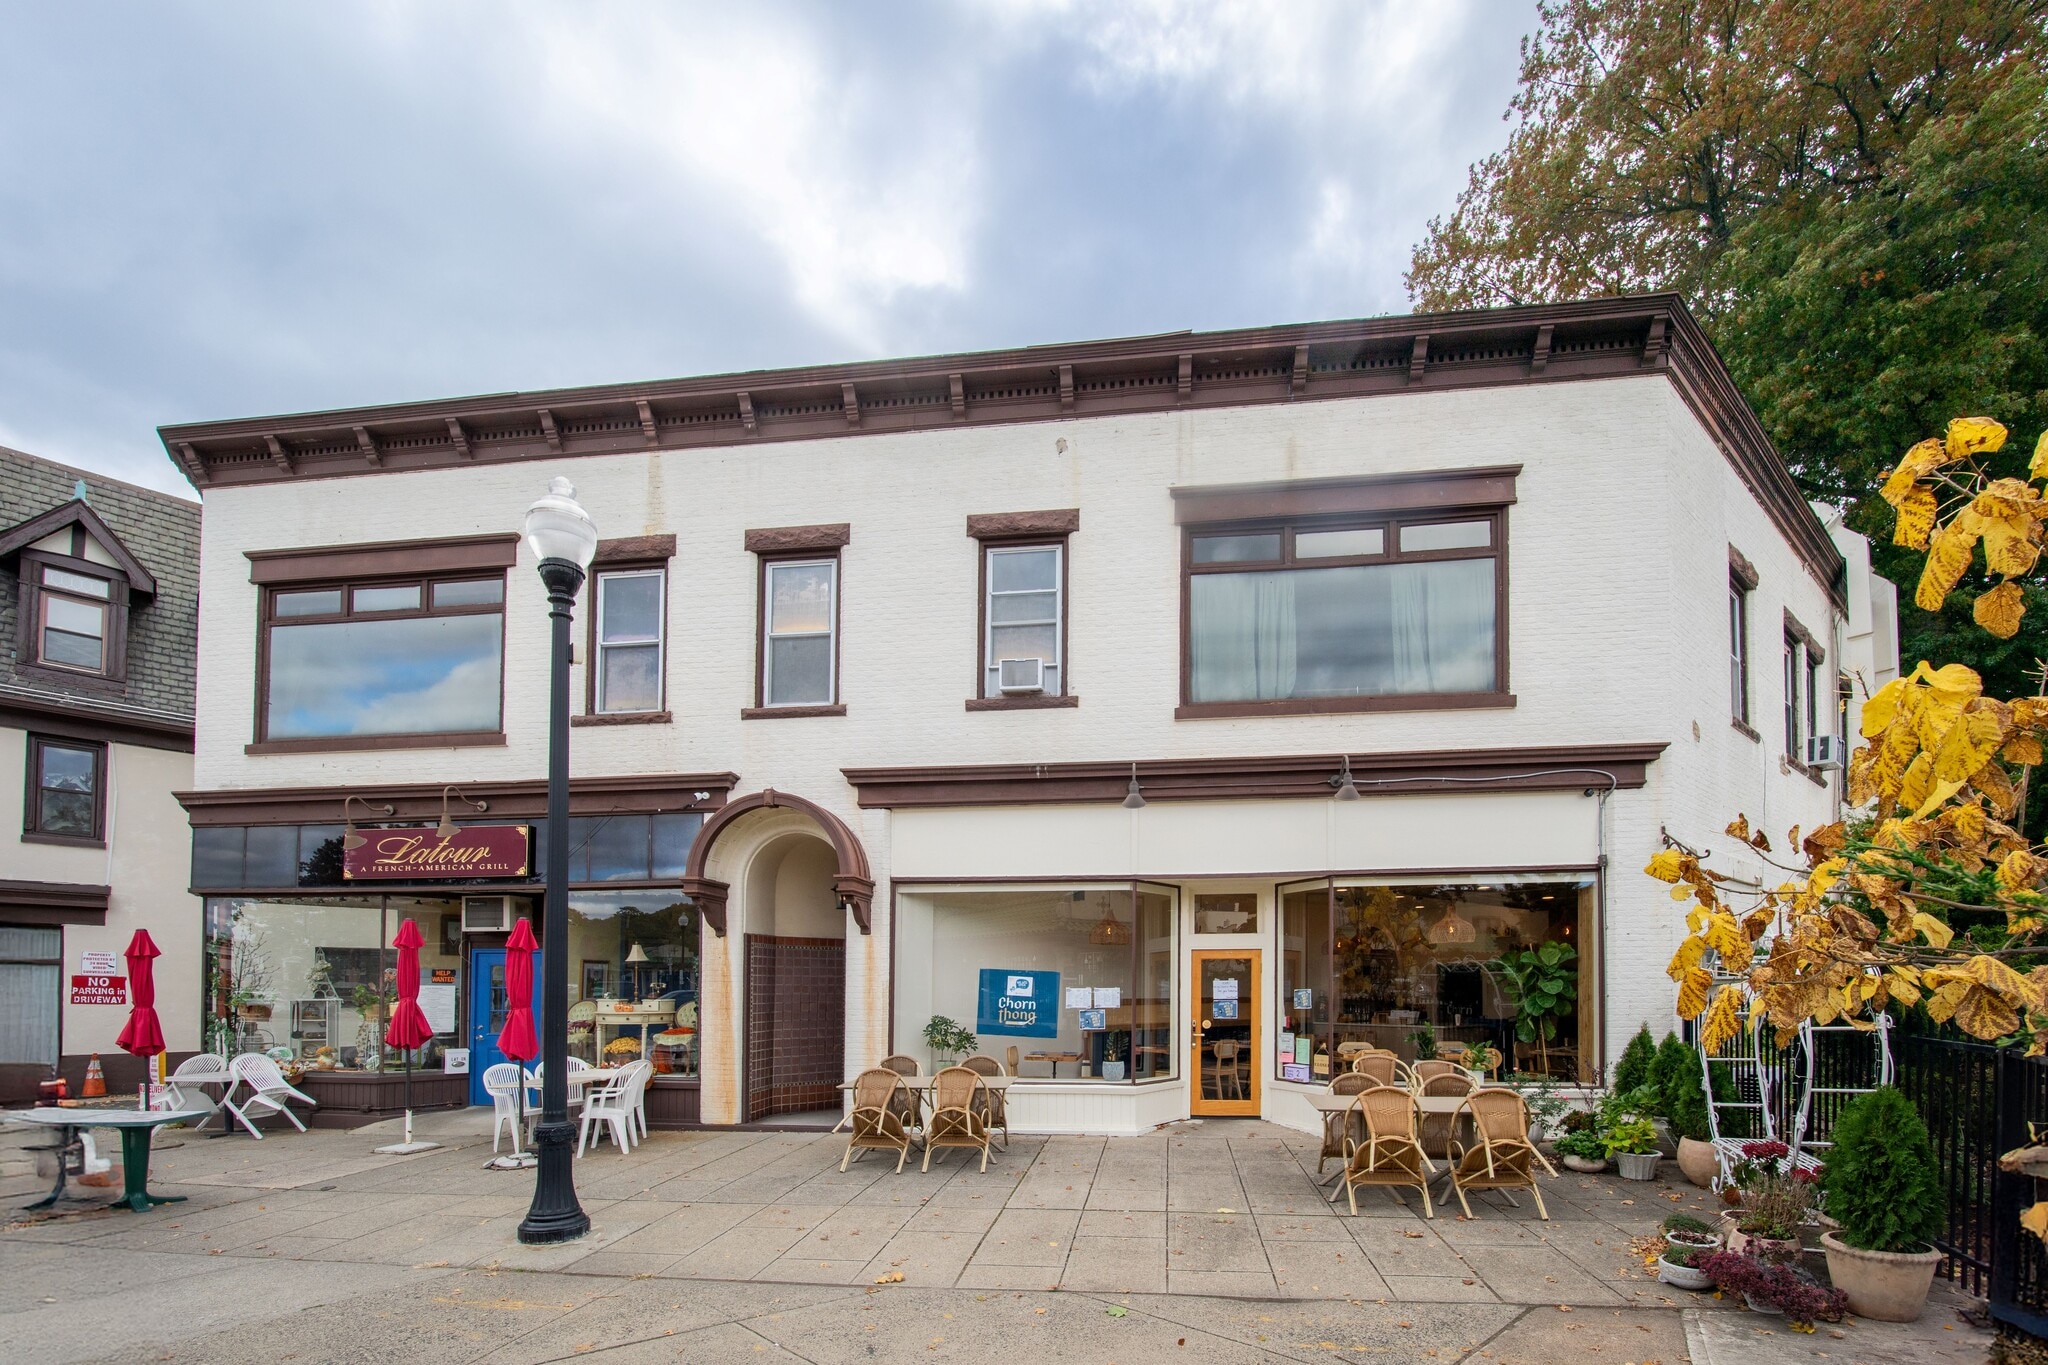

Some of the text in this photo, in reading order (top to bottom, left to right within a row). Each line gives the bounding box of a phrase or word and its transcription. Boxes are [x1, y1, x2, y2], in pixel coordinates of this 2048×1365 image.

[375, 835, 491, 864] Latour
[372, 863, 474, 872] FRENCH-AMERICAN
[88, 977, 110, 987] NO
[72, 987, 115, 995] PARKING
[998, 996, 1036, 1010] Chorn
[998, 1008, 1037, 1025] thong
